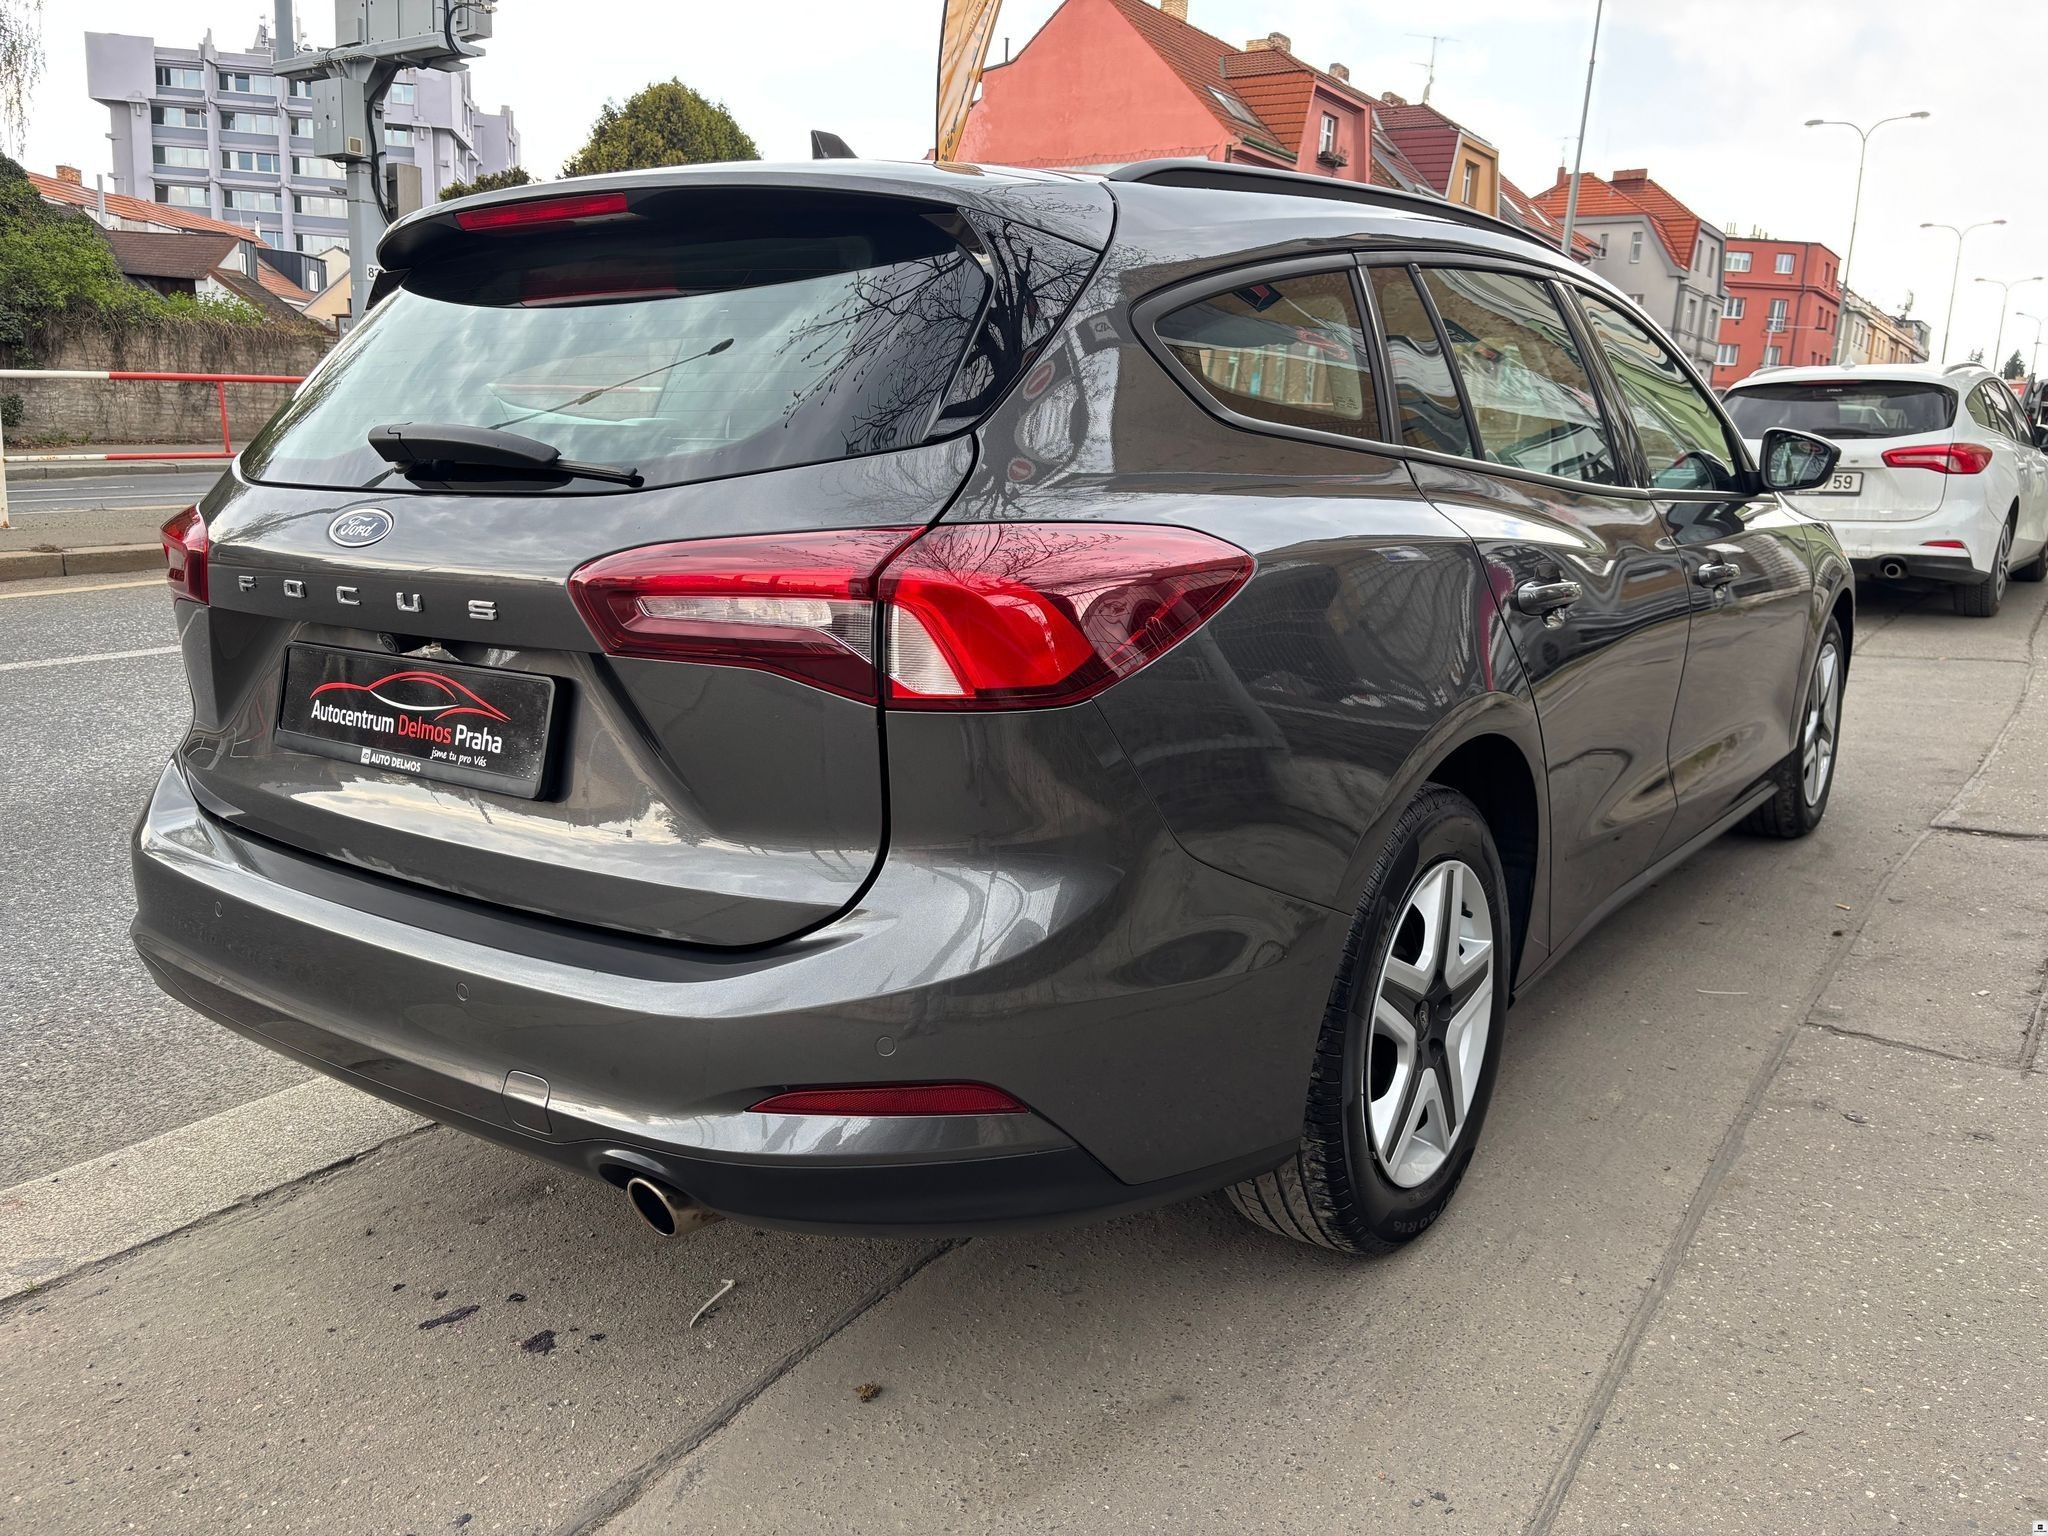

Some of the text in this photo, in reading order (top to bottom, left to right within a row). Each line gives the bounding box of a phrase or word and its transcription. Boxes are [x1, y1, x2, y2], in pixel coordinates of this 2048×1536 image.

[340, 516, 378, 537] Ford
[238, 576, 498, 620] FOCUS
[311, 700, 502, 753] Autocentrum Delmos Praha
[371, 753, 421, 772] AUTO DELMOS
[430, 747, 487, 767] jsme tu pro Vás
